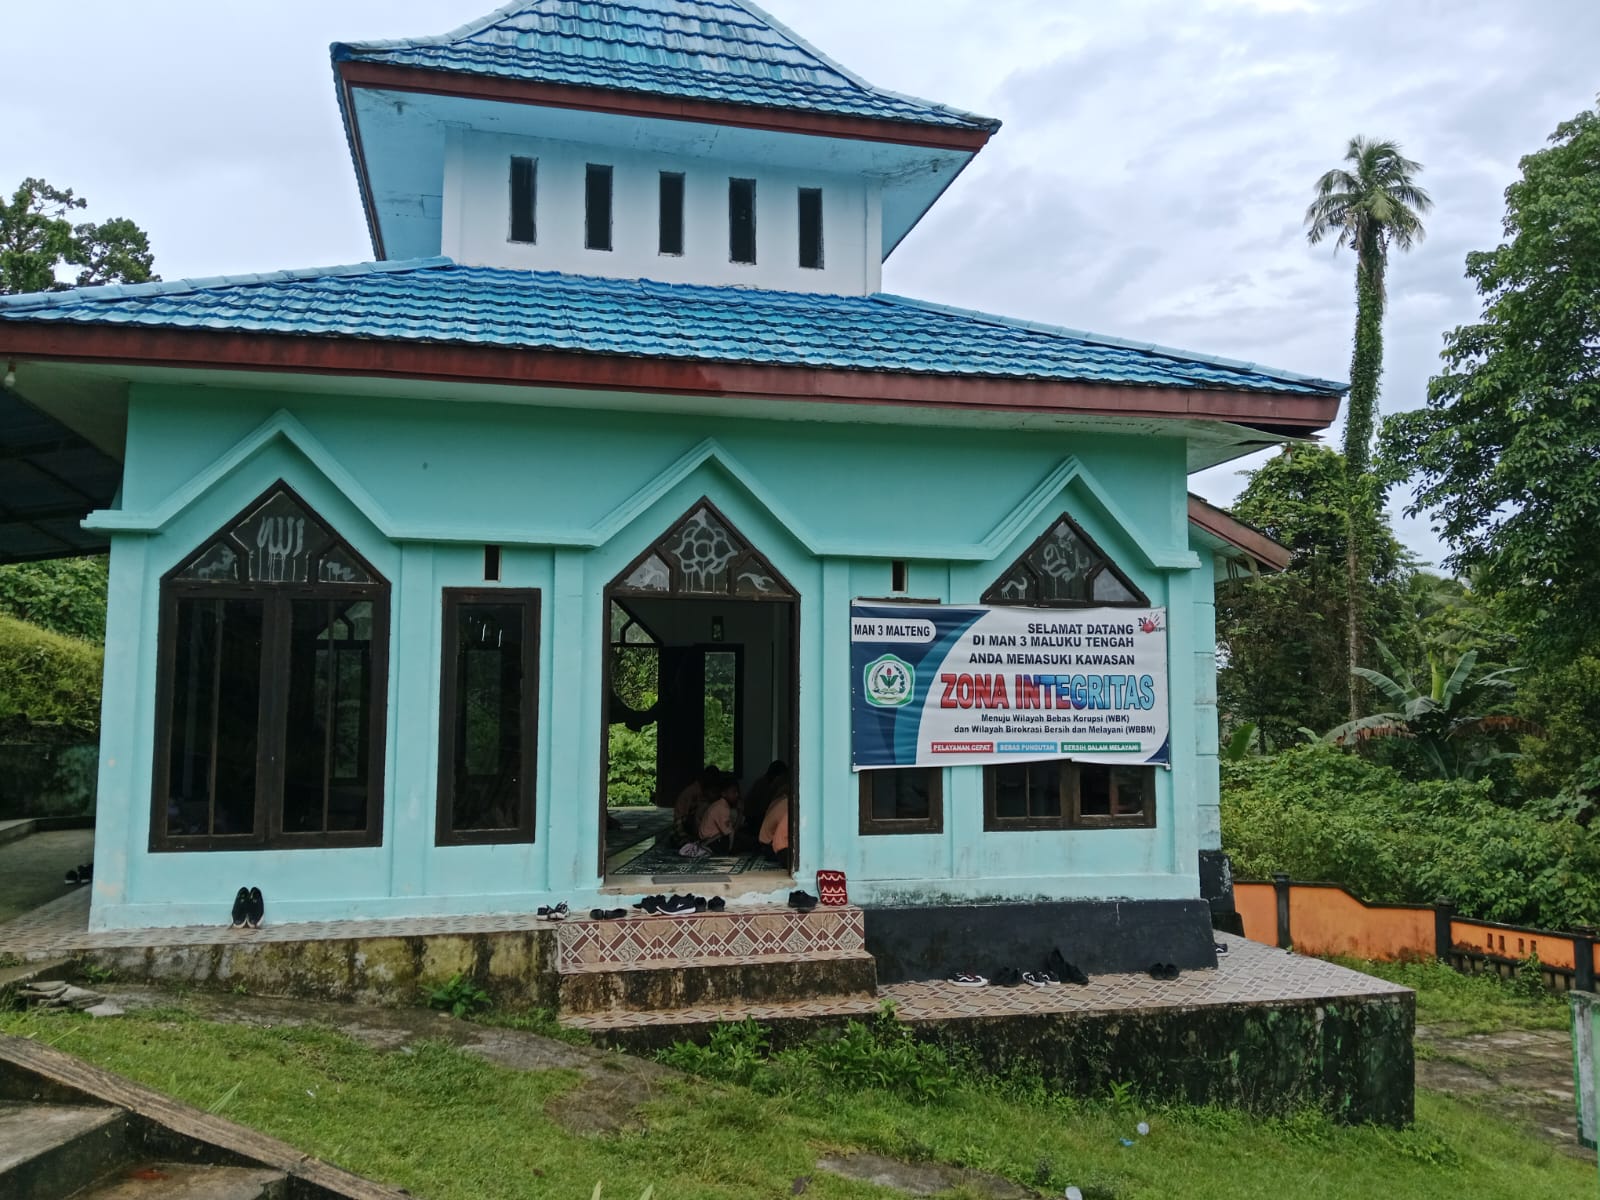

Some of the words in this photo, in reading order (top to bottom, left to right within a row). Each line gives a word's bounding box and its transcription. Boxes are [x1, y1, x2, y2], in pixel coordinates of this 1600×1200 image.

[854, 624, 875, 636] MAN
[877, 624, 884, 636] 3
[886, 625, 931, 637] MALTENG
[1027, 623, 1083, 635] SELAMAT
[1086, 624, 1134, 635] DATANG
[973, 635, 985, 646] DI
[989, 635, 1016, 646] MAN
[1020, 635, 1027, 647] 3
[1030, 636, 1082, 647] MALUKU
[1085, 636, 1134, 648] TENGAH
[969, 653, 1002, 664] ANDA
[1006, 653, 1072, 665] MEMASUKI
[1075, 654, 1135, 665] KAWASAN
[940, 673, 1010, 710] ZONA
[1015, 674, 1155, 711] INTEGRITAS
[981, 714, 1010, 724] Menuju
[1012, 714, 1044, 723] Wilayah
[1046, 714, 1071, 722] Bebas
[1073, 714, 1103, 724] Korupsi
[1105, 714, 1130, 724] (WBK)
[954, 725, 970, 733] dan
[971, 725, 1003, 734] Wilayah
[1005, 725, 1042, 733] Birokrasi
[1044, 725, 1070, 733] Bersih
[1088, 725, 1123, 735] Melayani
[1125, 725, 1156, 735] (WBBM)
